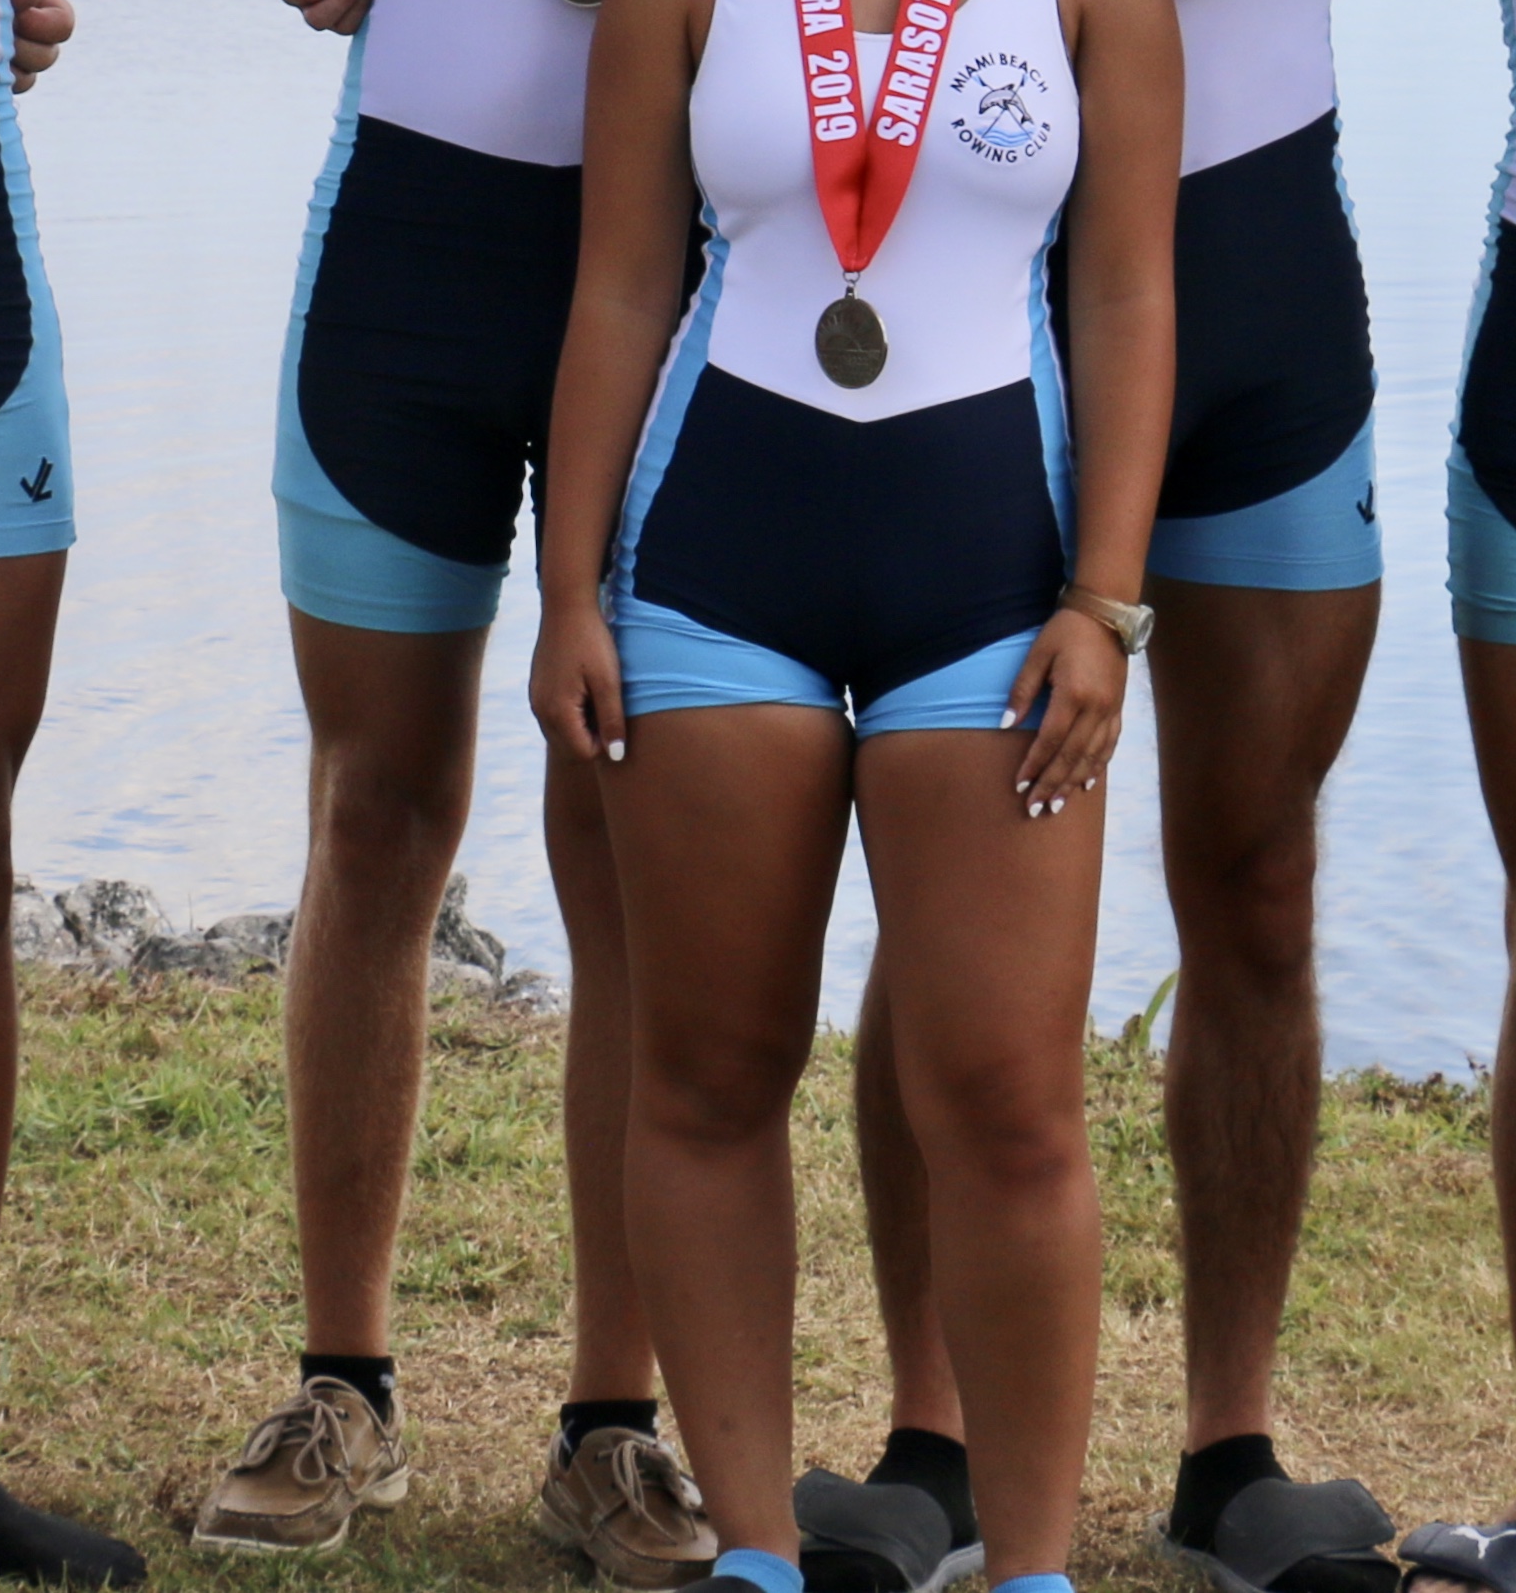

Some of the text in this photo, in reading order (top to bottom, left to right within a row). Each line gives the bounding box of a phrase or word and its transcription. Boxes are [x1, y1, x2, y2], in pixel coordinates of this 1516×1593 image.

[950, 52, 1049, 94] MIAMI BEACH
[807, 50, 858, 143] 2019
[950, 118, 1052, 164] ROWING CLUB
